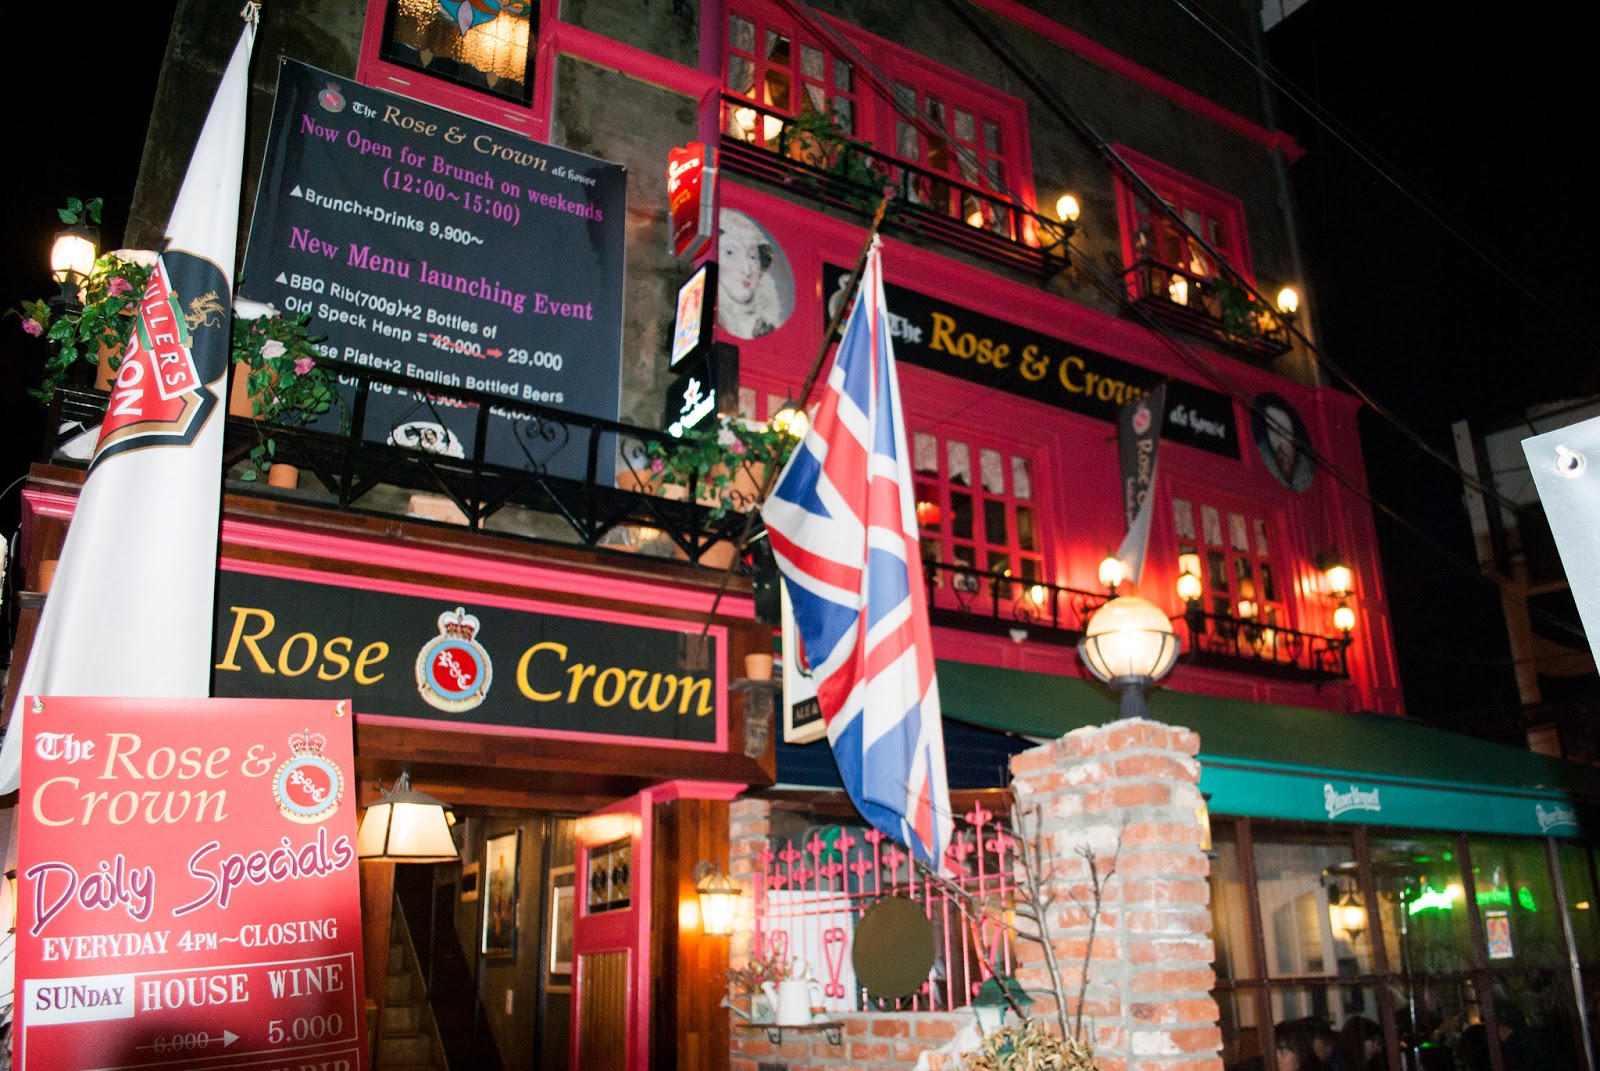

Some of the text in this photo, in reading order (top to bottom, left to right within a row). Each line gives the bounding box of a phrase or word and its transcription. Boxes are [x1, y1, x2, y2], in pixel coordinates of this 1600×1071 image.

[352, 101, 377, 120] The
[381, 104, 437, 137] Rose
[444, 126, 466, 144] &
[473, 135, 547, 172] Crown
[301, 114, 604, 223] Now Open for Brunch on weekends
[383, 167, 521, 227] (12:00~15:00)
[305, 188, 425, 234] Brunch+Drinks
[288, 227, 594, 321] New Menu launching Event
[285, 296, 312, 314] Old
[317, 303, 367, 329] Speck
[372, 319, 412, 342] Henp
[507, 348, 563, 372] 29,000
[290, 273, 498, 340] BBQ Rib(700g)+2 Bottles of
[343, 346, 402, 374] Plate+2
[465, 375, 519, 397] Bottled
[523, 384, 565, 404] Beers
[887, 312, 922, 344] The
[928, 312, 1011, 370] Rose
[1019, 344, 1050, 382] &
[1059, 356, 1149, 405] Crow
[215, 606, 390, 686] Rose
[515, 641, 713, 718] Crown
[35, 732, 277, 780] The Rose &
[32, 776, 229, 827] Crown
[25, 826, 353, 936] Daily Specials
[42, 930, 171, 961] EVERYDAY
[36, 964, 344, 1012] SUNDAY HOUSE WINE
[267, 1013, 343, 1043] 5.000
